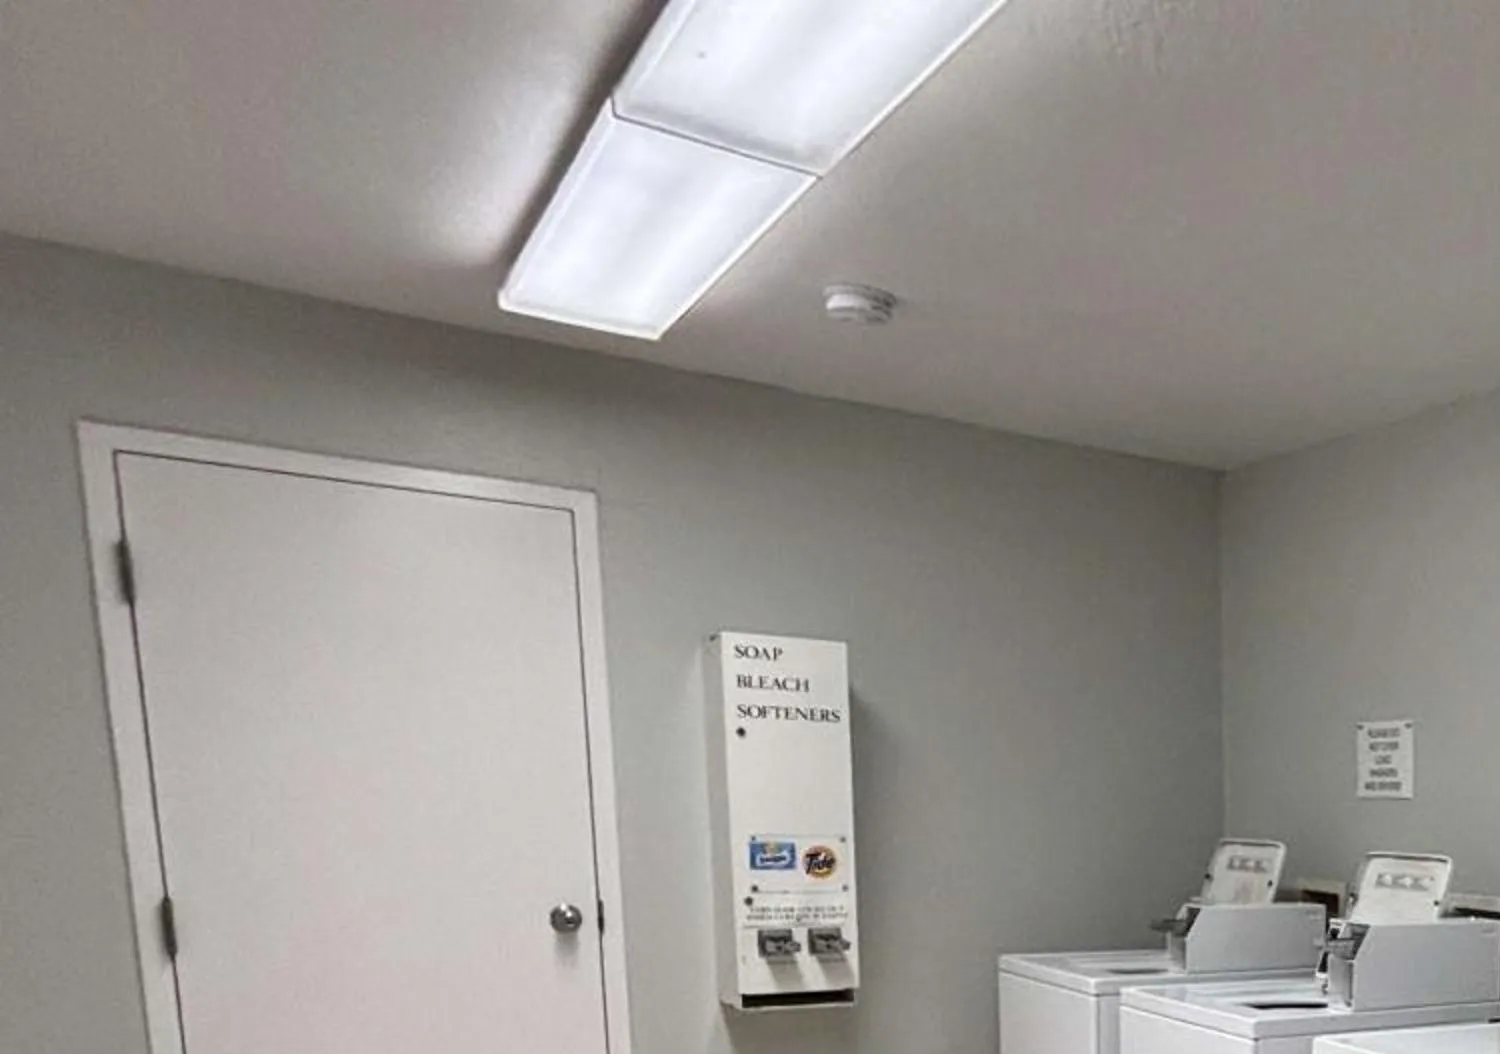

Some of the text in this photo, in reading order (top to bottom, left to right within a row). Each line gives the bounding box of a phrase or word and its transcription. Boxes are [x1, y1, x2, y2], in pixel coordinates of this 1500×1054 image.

[734, 645, 783, 661] SOAP
[736, 674, 809, 692] BLEACH
[736, 704, 841, 723] SOFTENERS
